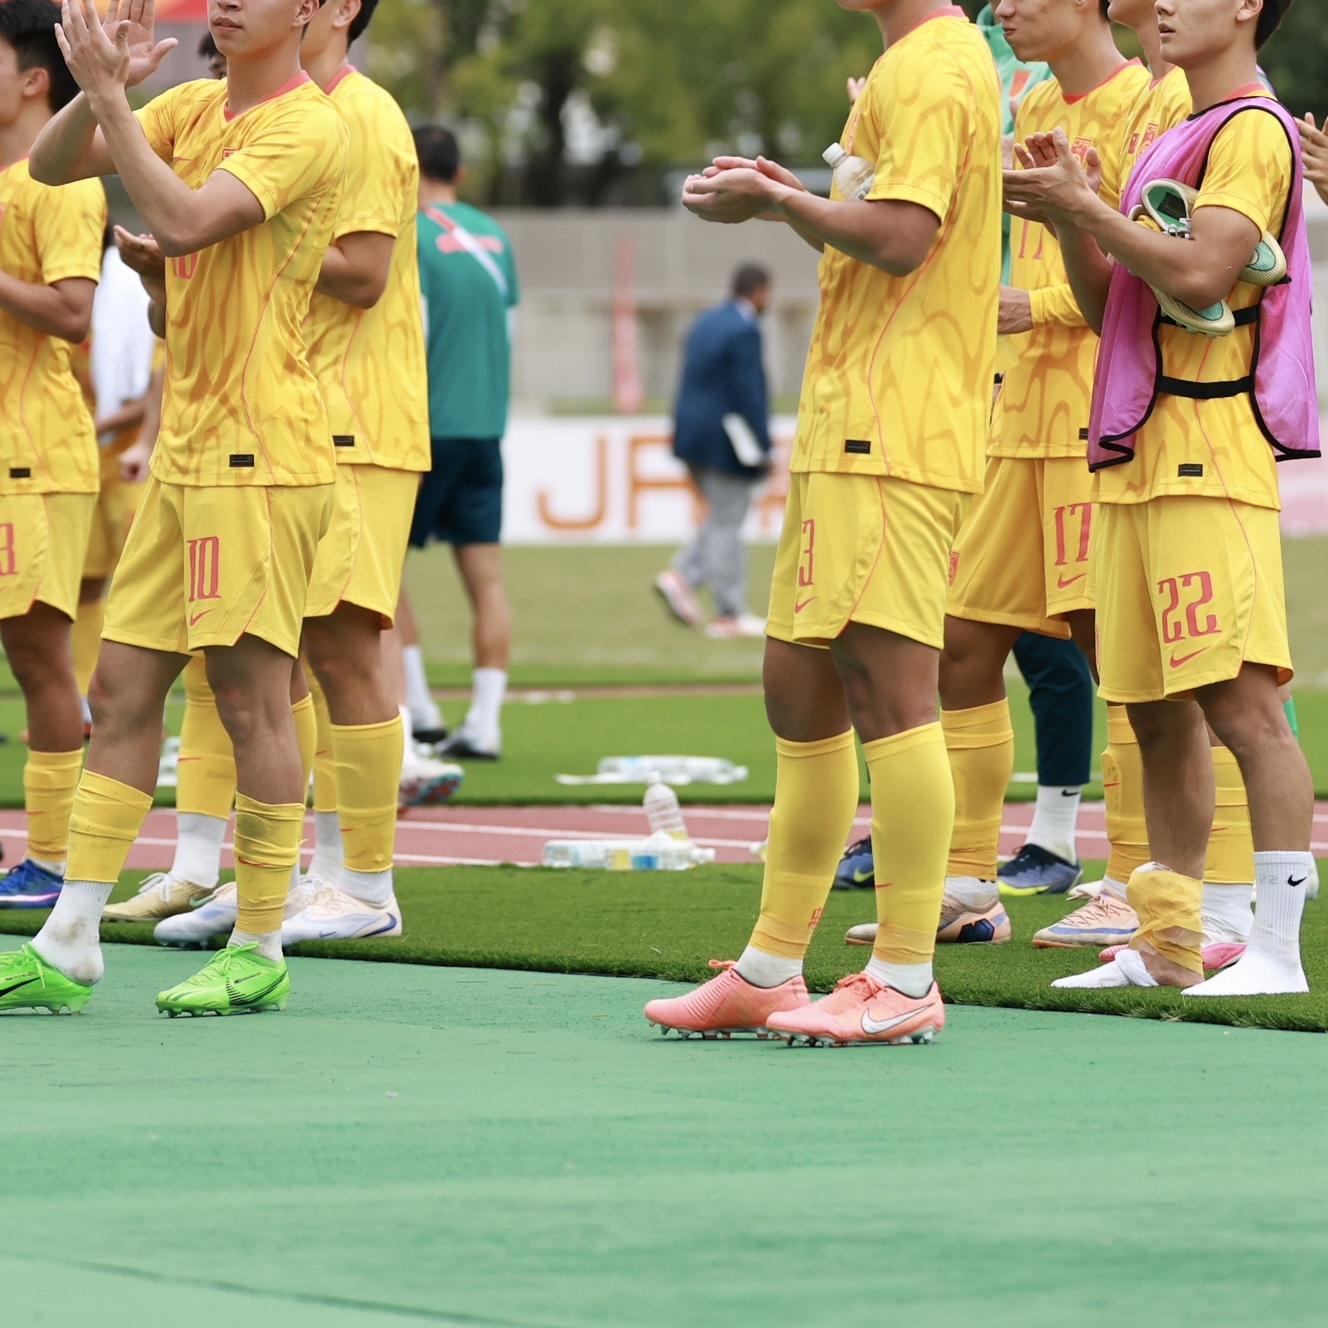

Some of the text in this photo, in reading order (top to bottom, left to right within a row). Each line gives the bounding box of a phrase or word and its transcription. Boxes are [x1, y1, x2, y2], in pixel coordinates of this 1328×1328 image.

[798, 518, 815, 587] 3
[1052, 501, 1093, 566] 17
[186, 535, 221, 603] 10
[1157, 570, 1223, 644] 22
